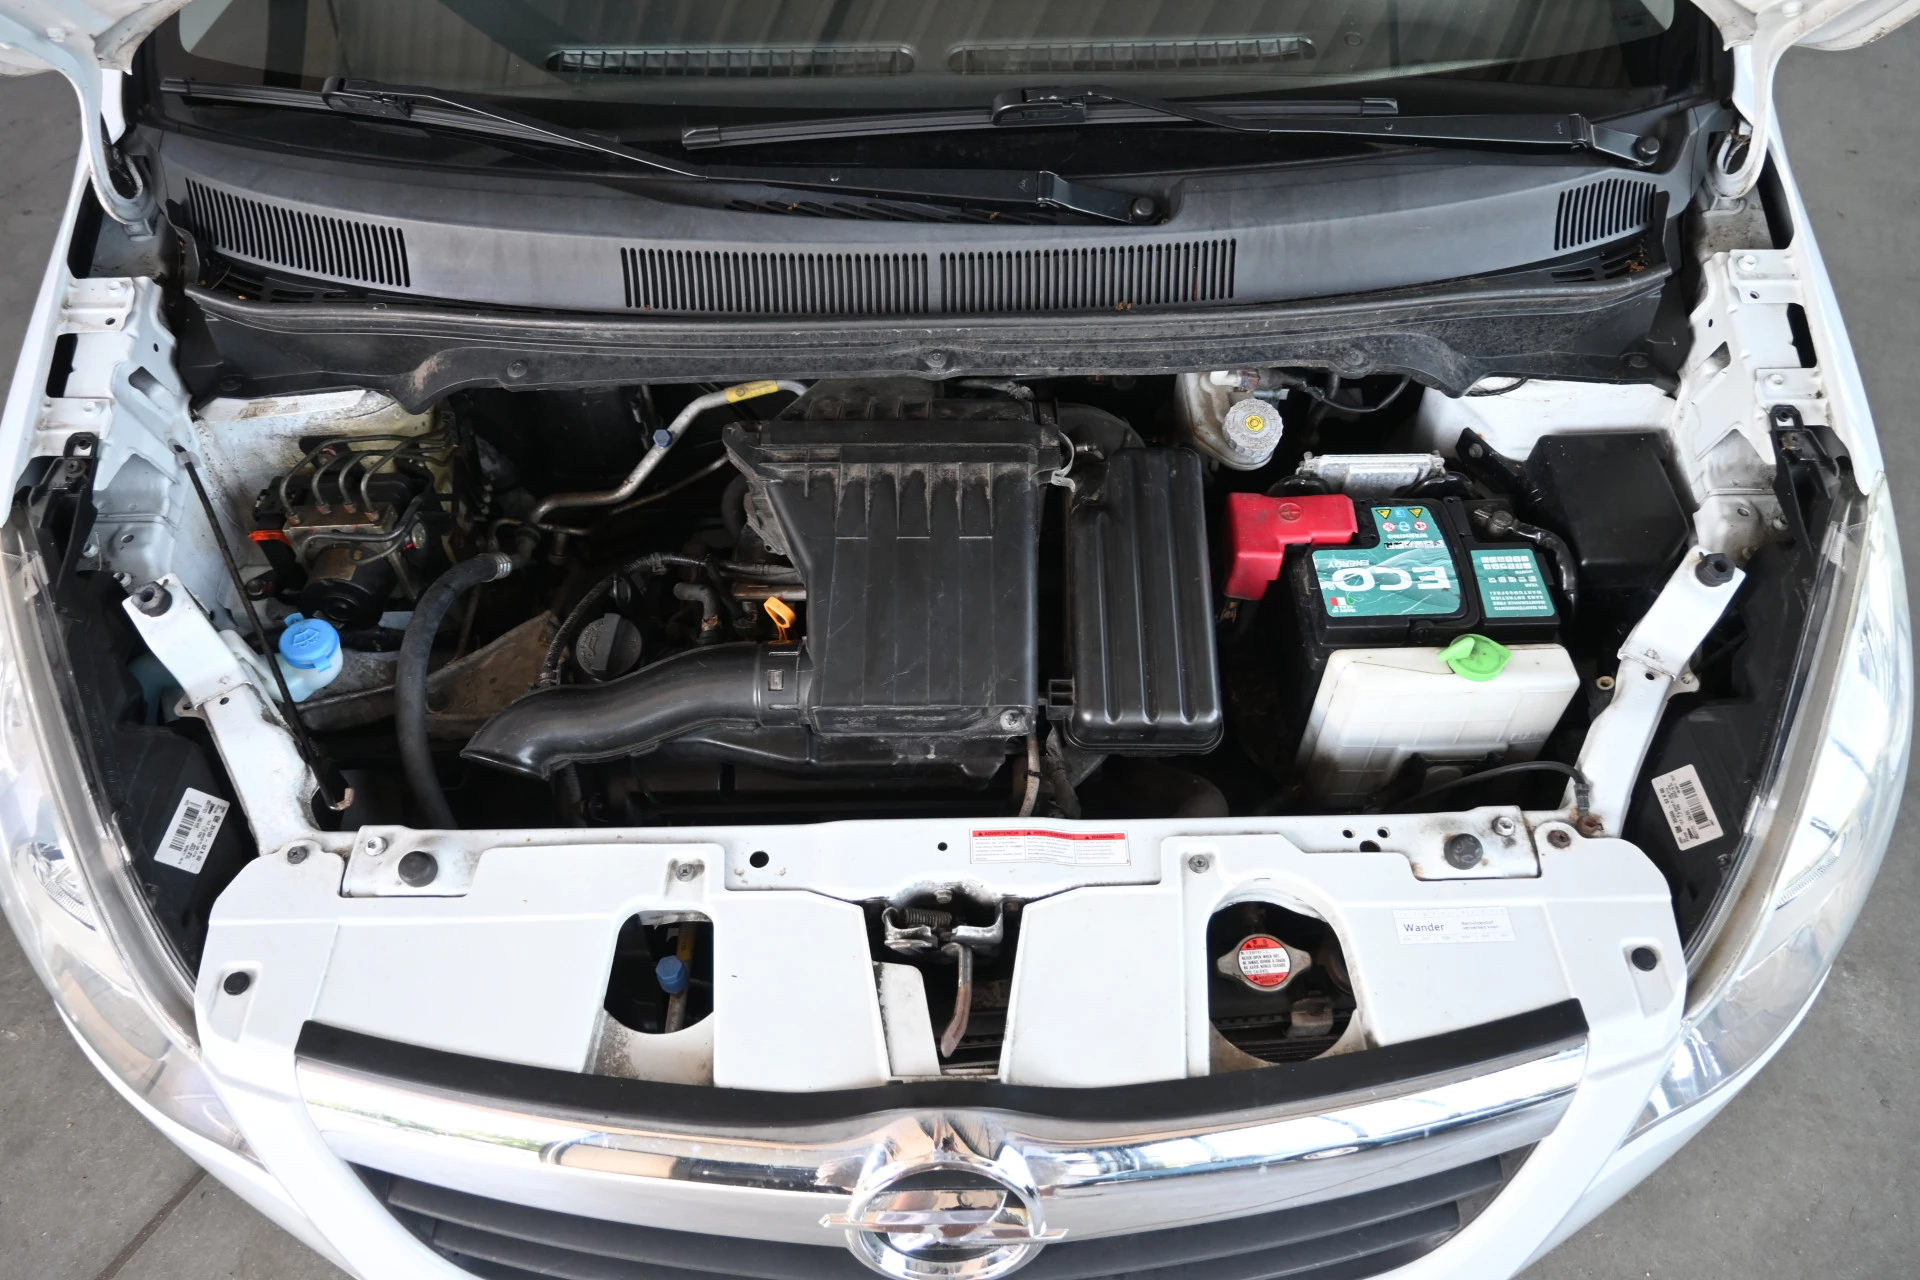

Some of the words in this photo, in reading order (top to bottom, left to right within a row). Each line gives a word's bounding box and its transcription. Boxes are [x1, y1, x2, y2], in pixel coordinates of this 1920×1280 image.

[1327, 559, 1370, 569] ENERGY
[1331, 566, 1451, 592] ECO
[1403, 923, 1445, 932] Wander
